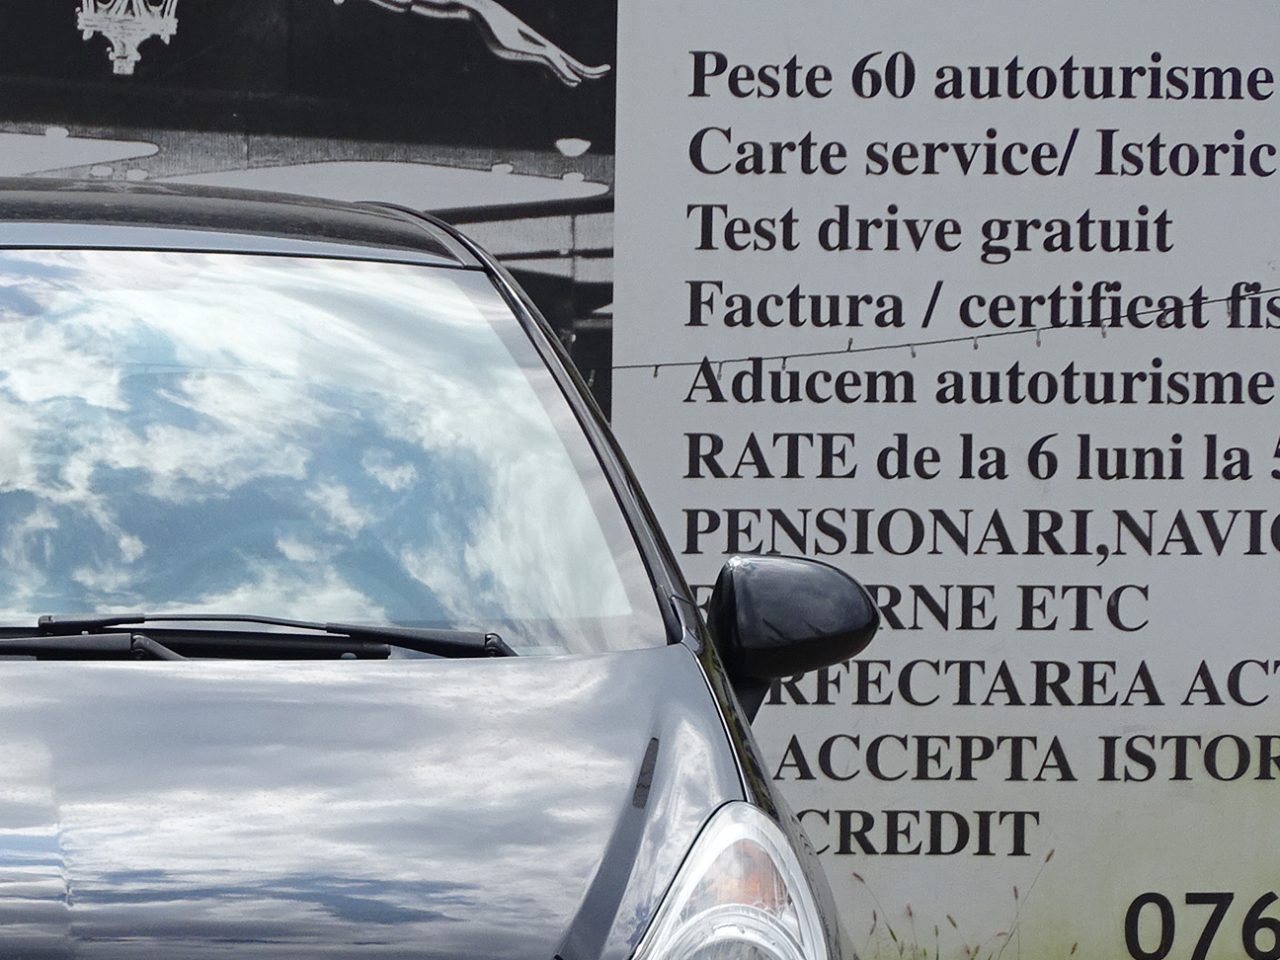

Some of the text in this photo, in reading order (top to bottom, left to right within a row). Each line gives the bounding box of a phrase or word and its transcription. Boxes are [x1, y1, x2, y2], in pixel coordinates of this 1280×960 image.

[688, 50, 1274, 101] Peste 60 autoturisme
[688, 126, 1277, 178] Carte service/ Istoric
[686, 203, 1174, 265] Test drive gratuit
[684, 280, 905, 328] Factura
[921, 280, 944, 329] /
[959, 280, 1209, 330] certificat
[683, 355, 1275, 406] Aducem autoturisme
[682, 432, 858, 479] RATE
[876, 432, 941, 480] de
[959, 433, 1009, 481] la
[1027, 433, 1058, 481] 6
[1076, 432, 1185, 481] luni
[1203, 433, 1253, 481] la
[682, 507, 1280, 567] PENSIONARI,NAVI
[1016, 584, 1149, 632] ETC
[764, 658, 1280, 707] RFECTAREA AC
[772, 733, 1078, 782] ACCEPTA
